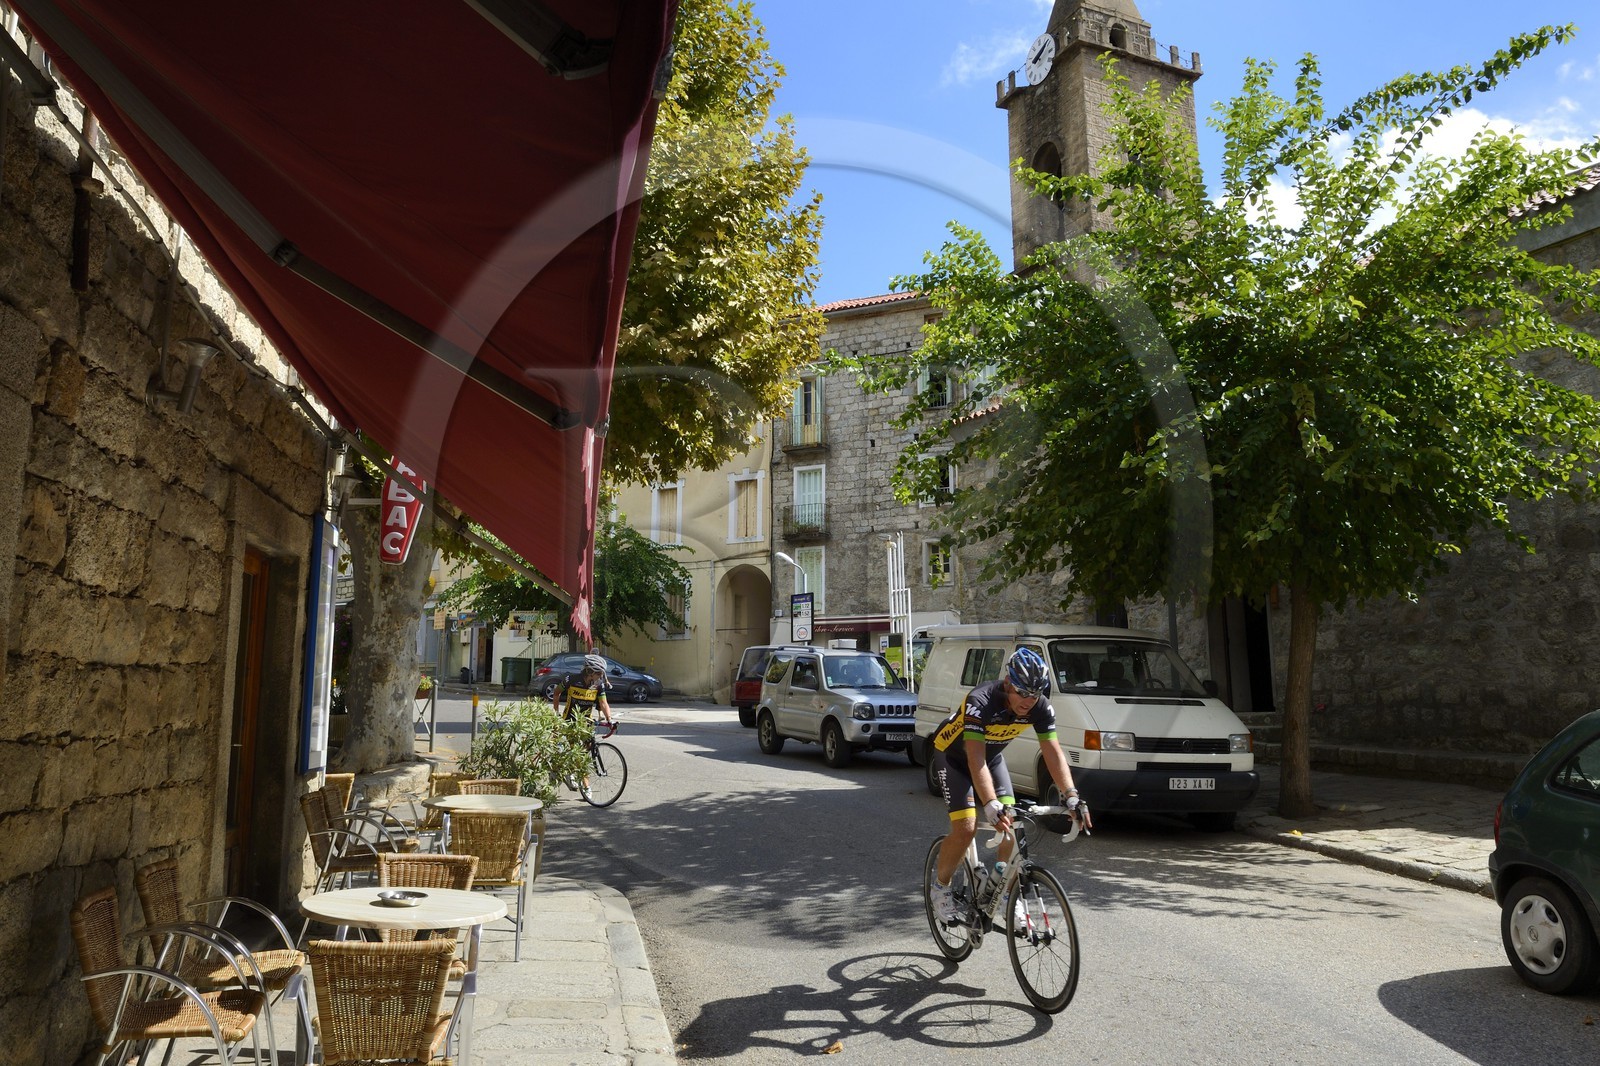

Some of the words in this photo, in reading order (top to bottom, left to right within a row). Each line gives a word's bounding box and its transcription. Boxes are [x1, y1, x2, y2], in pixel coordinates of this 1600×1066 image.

[1171, 779, 1188, 789] 123
[1193, 779, 1202, 789] XA
[1205, 779, 1214, 789] 14
